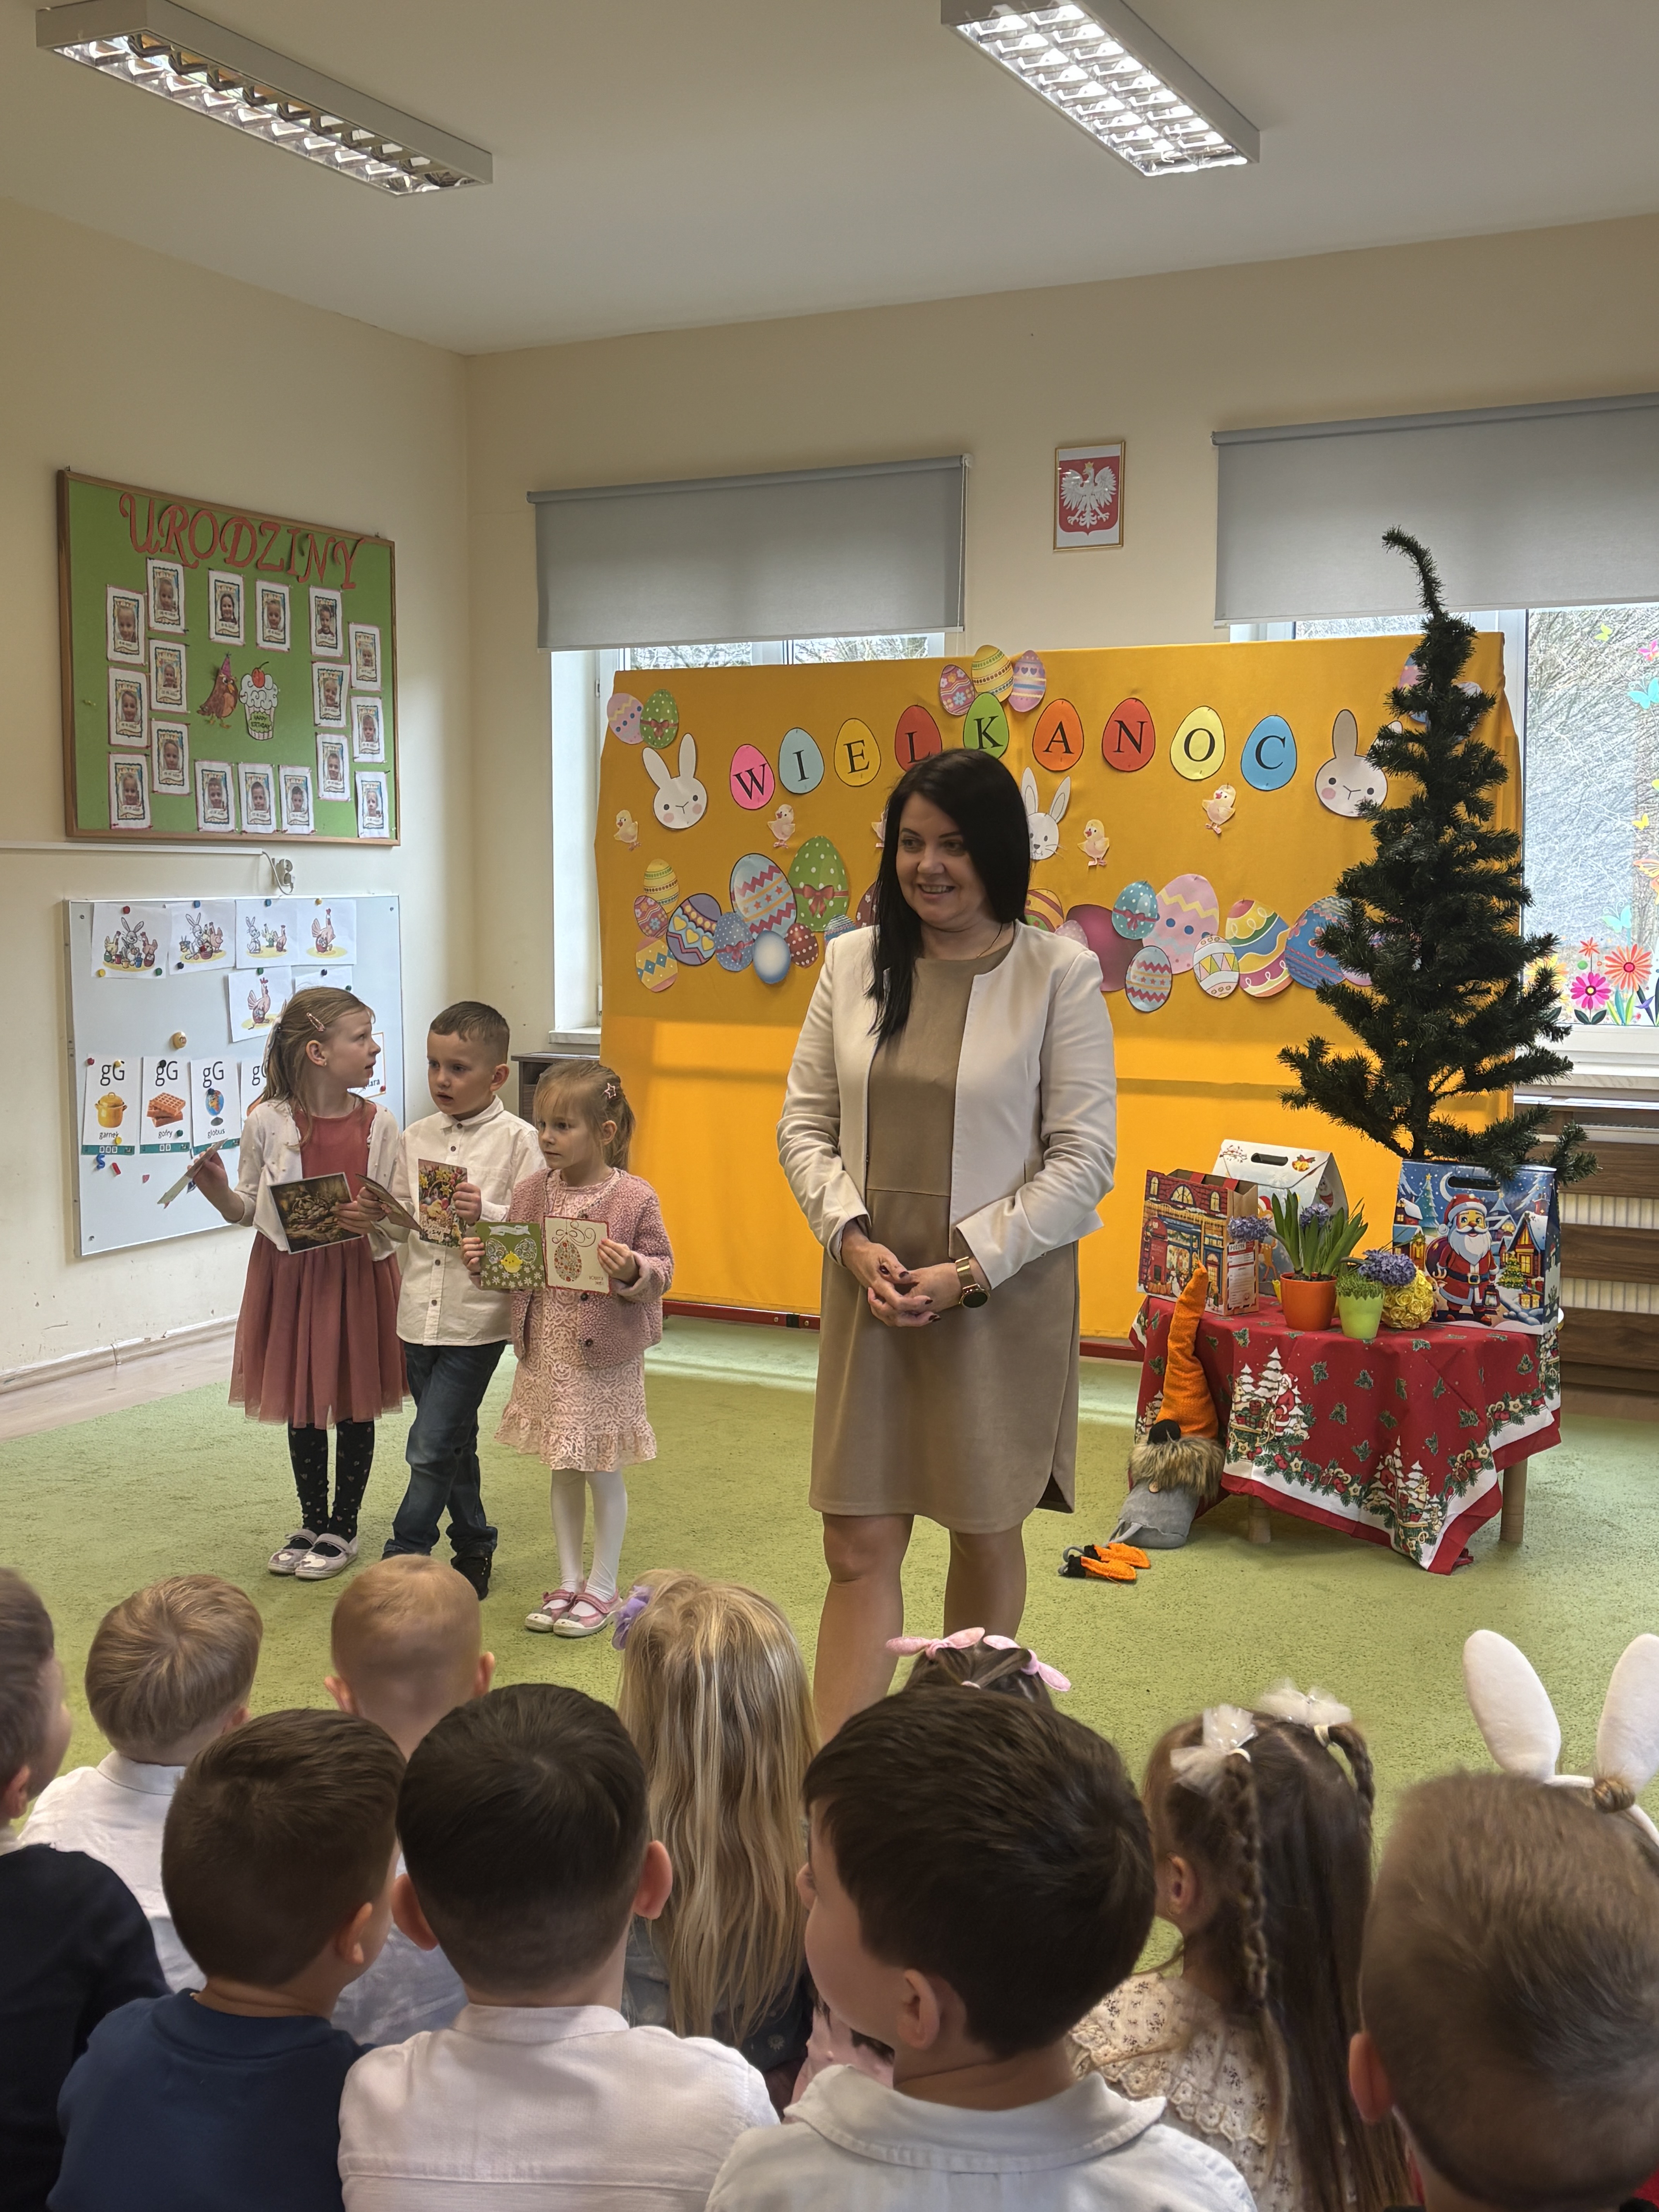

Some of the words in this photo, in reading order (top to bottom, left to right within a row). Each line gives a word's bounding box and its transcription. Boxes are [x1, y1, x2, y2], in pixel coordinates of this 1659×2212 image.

[119, 493, 365, 589] URODZINY
[732, 715, 1286, 800] WIELKANOC
[100, 1060, 125, 1086] gG
[155, 1061, 178, 1086] gG
[203, 1061, 224, 1088] gG
[99, 1131, 119, 1139] garnek
[158, 1129, 173, 1139] gofry
[207, 1129, 225, 1139] globus
